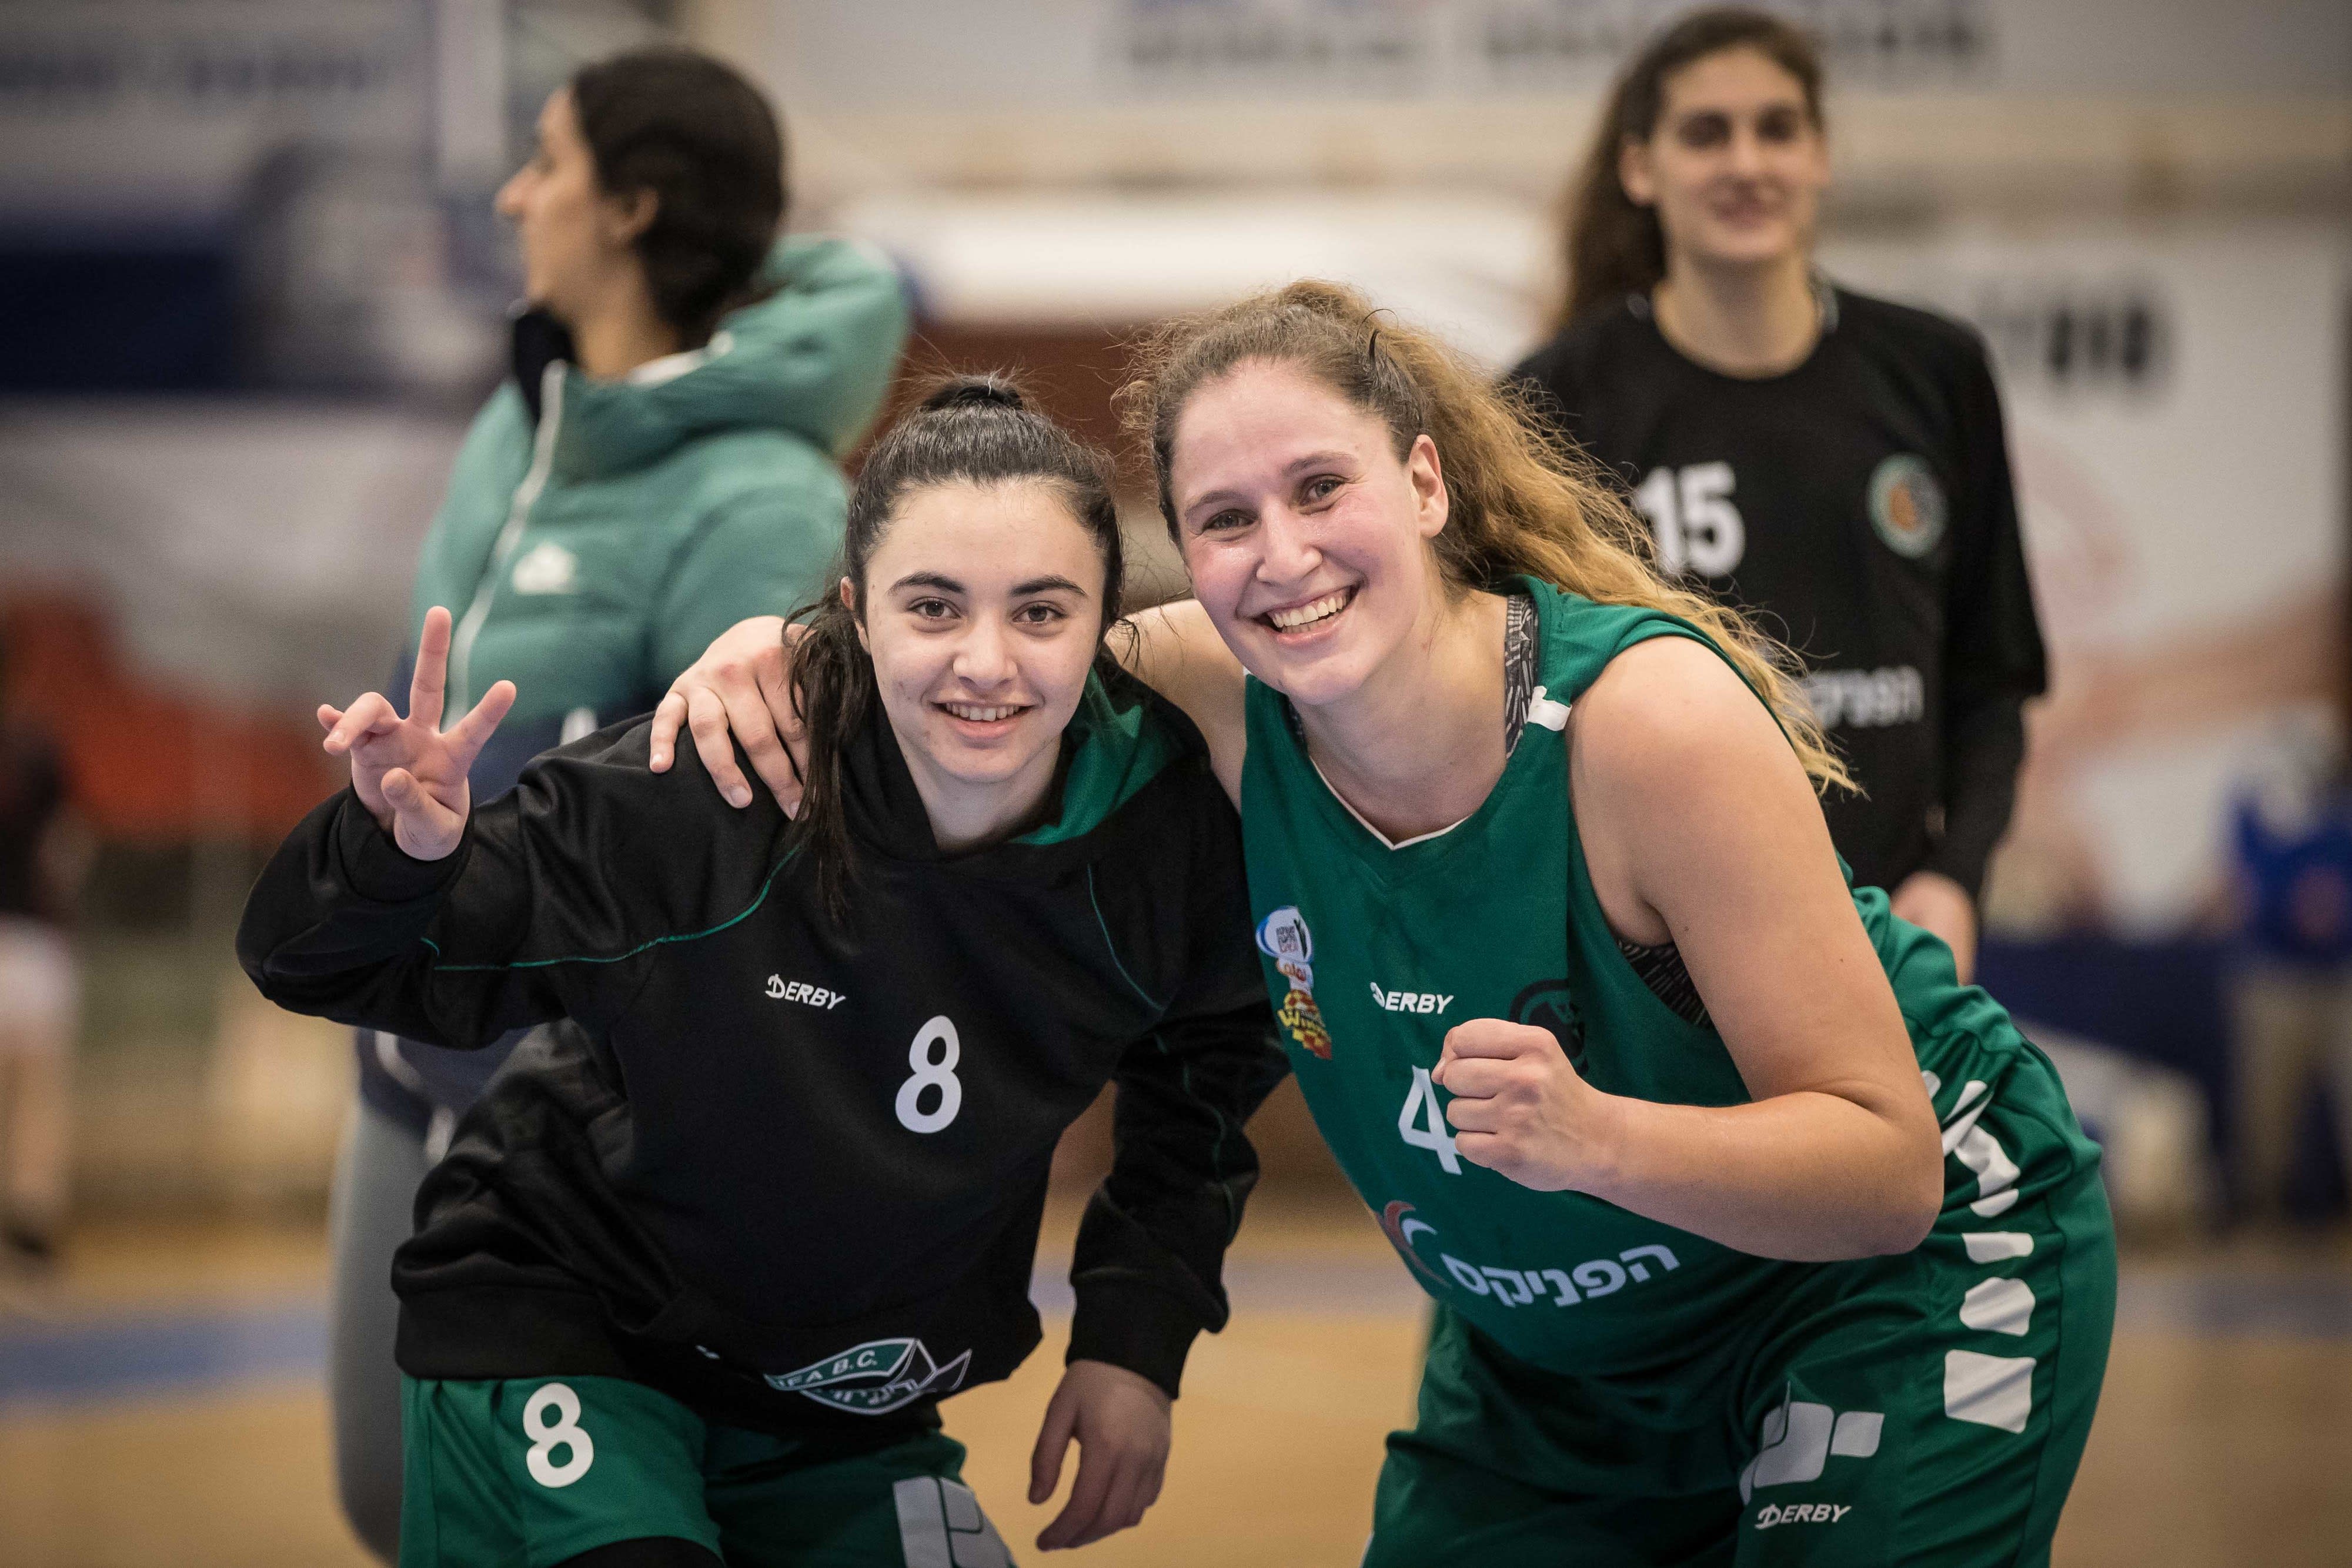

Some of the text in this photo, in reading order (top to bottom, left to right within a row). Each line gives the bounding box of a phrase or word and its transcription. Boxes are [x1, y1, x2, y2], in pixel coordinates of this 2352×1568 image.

[1633, 462, 1746, 577] 15
[764, 973, 846, 1010] DERBY
[1369, 981, 1454, 1014] DERBY
[895, 1015, 962, 1134] 8
[1398, 1065, 1463, 1175] 4
[1440, 1244, 1680, 1308] הפניקס
[523, 1383, 594, 1488] 8
[1755, 1503, 1851, 1530] DERBY
